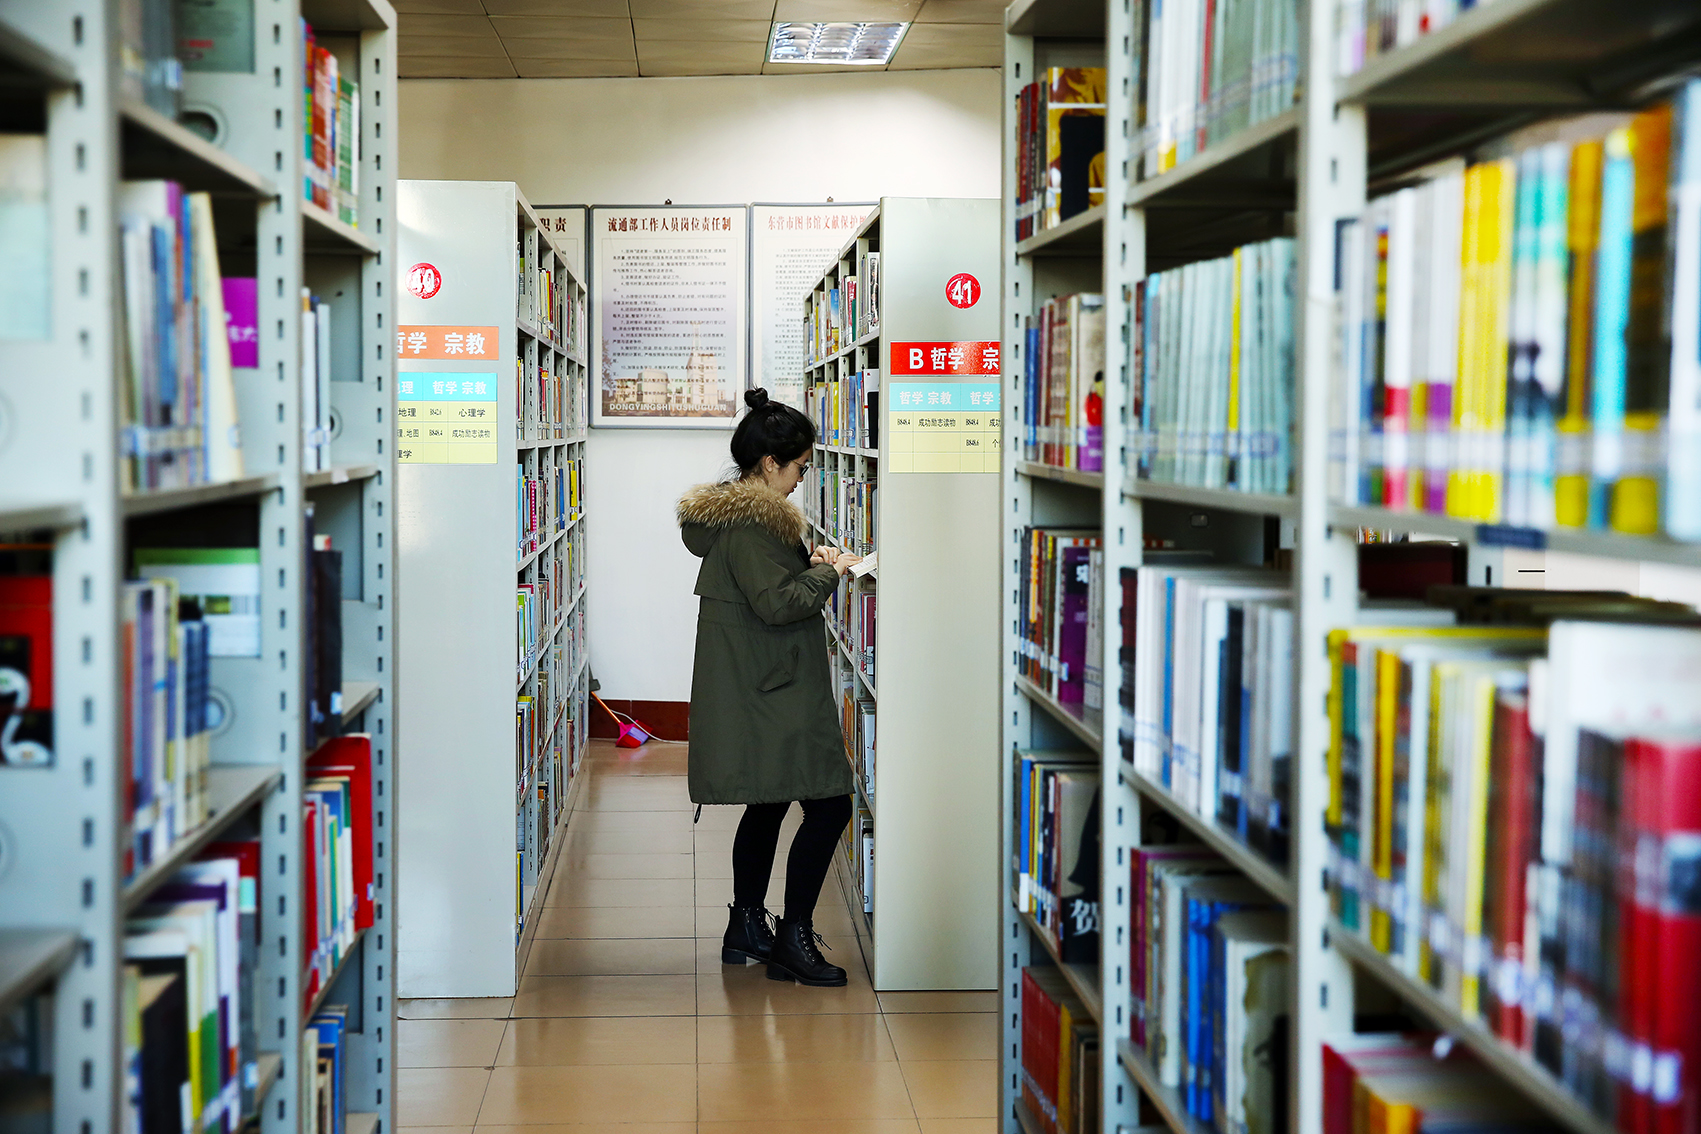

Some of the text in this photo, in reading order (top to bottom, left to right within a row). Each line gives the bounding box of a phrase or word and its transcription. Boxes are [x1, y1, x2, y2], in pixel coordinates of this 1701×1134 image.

[608, 216, 731, 232] 流通部工作人员岗位责任制
[951, 279, 972, 304] 41
[444, 332, 486, 355] 宗教
[909, 348, 924, 370] B
[930, 346, 965, 370] 哲学
[398, 381, 414, 395] 理
[432, 380, 487, 395] 哲学 宗教
[899, 390, 952, 405] 哲学 宗教
[969, 390, 994, 405] 哲学
[458, 408, 486, 418] 心理学
[609, 403, 727, 411] DONGYINGSHITUSHUGUAN
[918, 418, 956, 428] 成功励志读物
[451, 429, 491, 438] 成功励志读物
